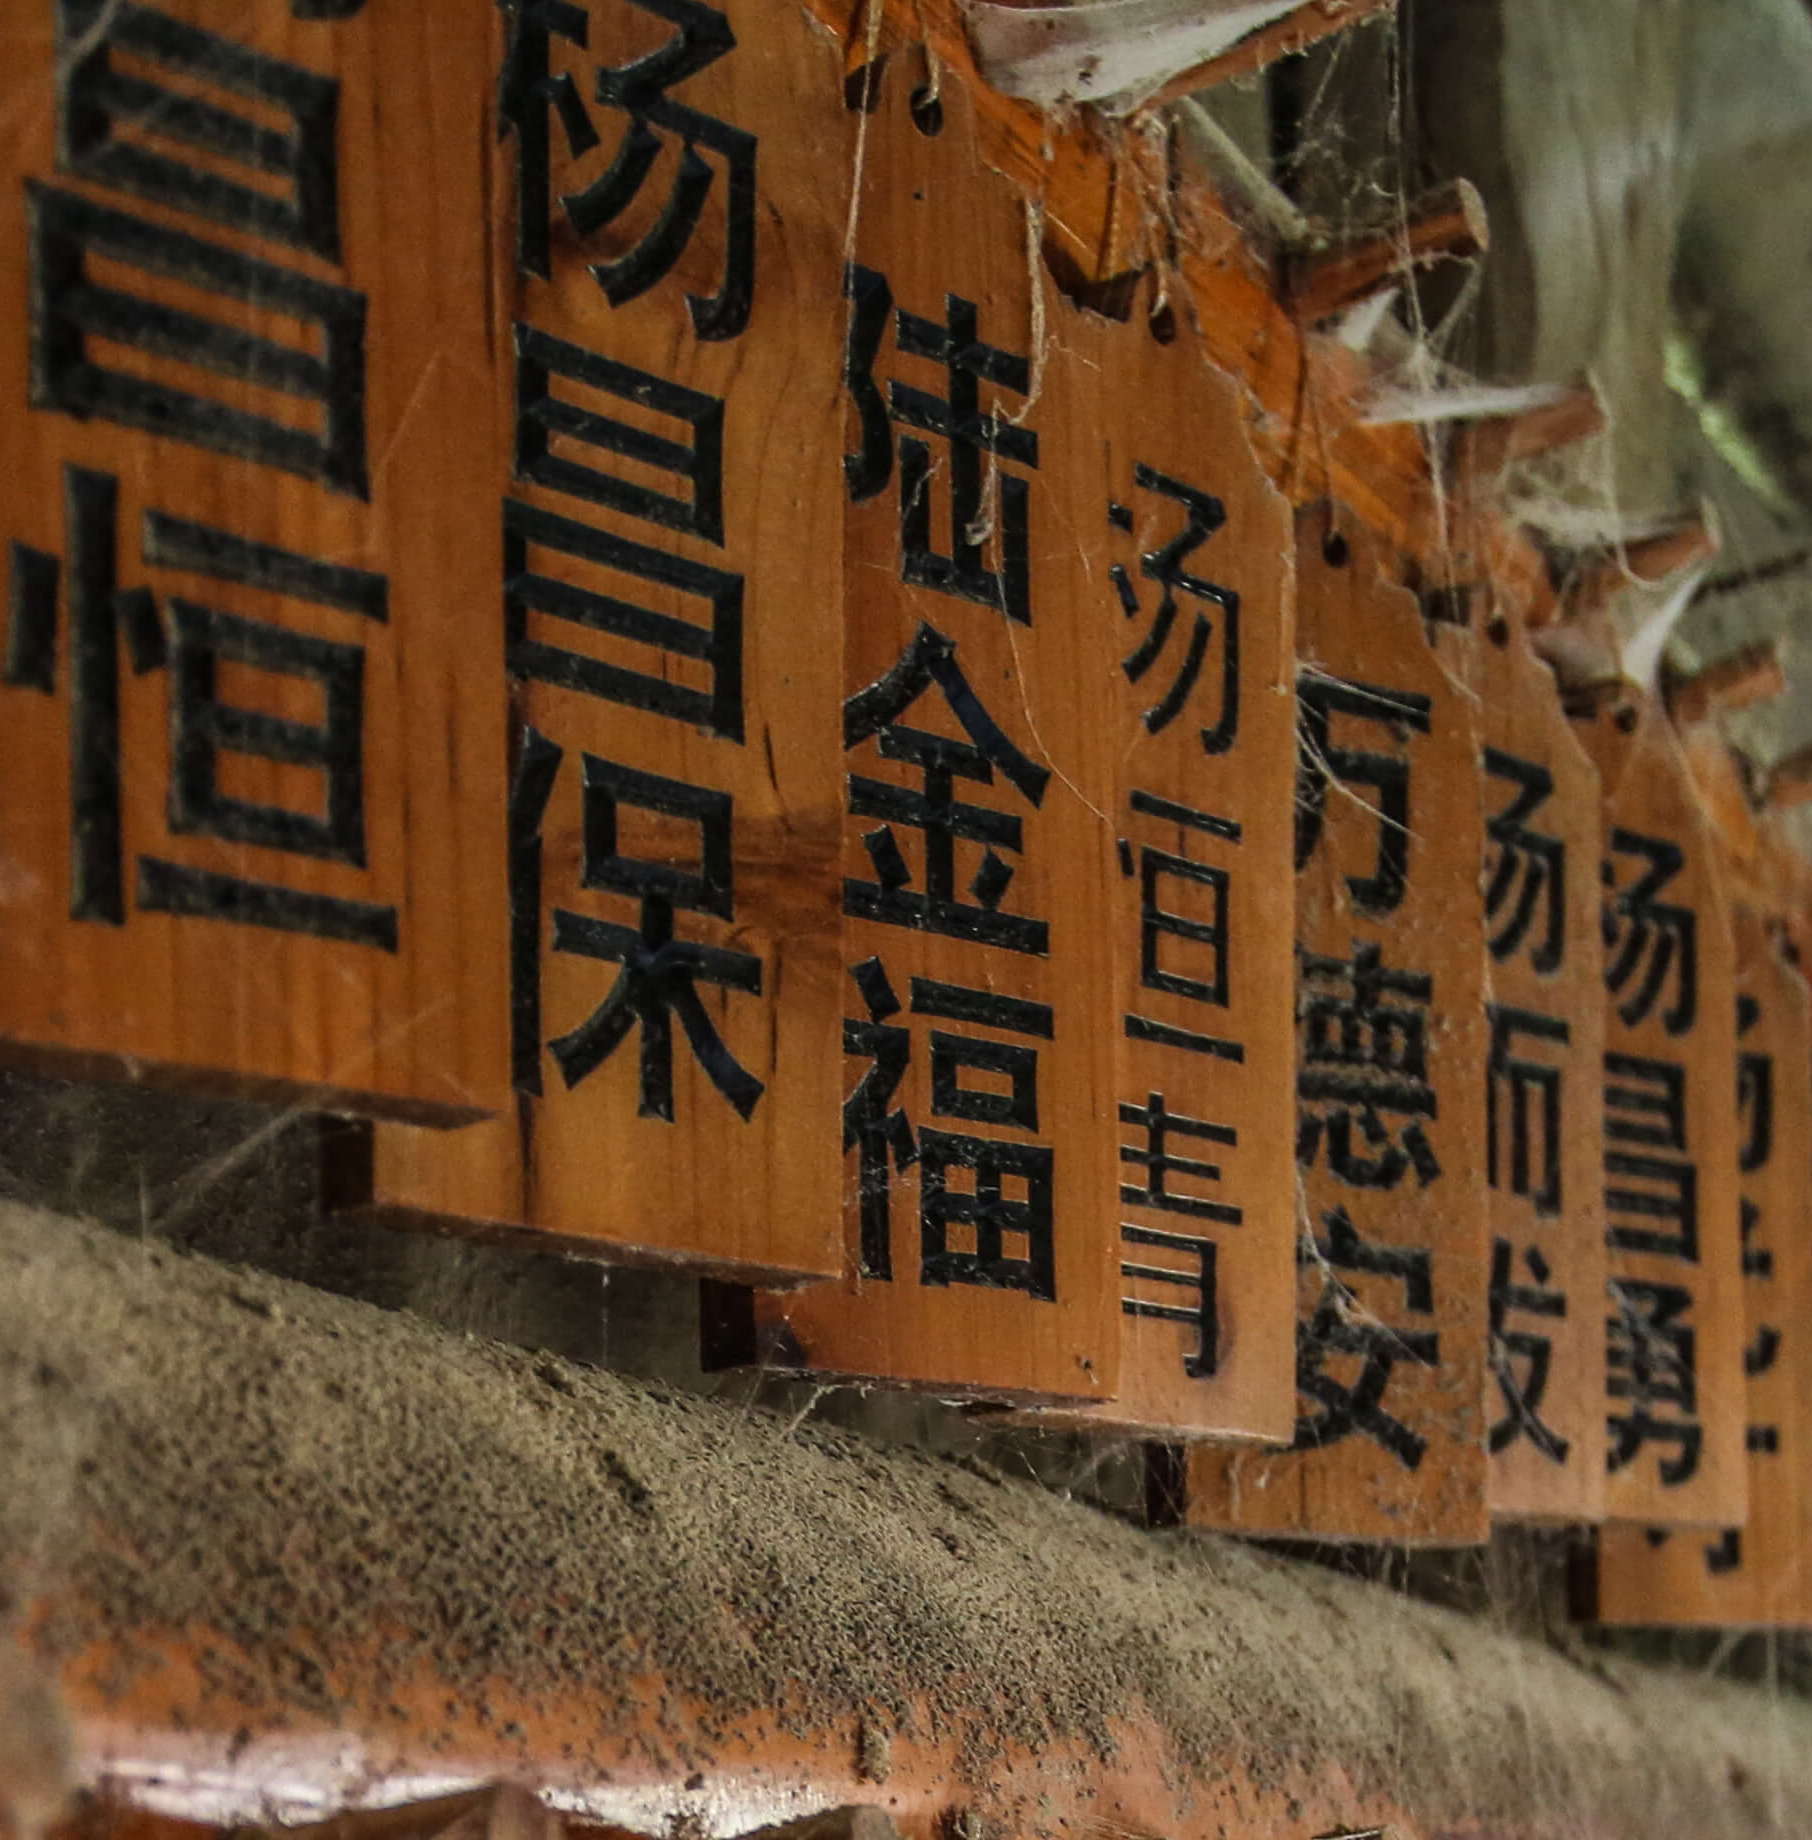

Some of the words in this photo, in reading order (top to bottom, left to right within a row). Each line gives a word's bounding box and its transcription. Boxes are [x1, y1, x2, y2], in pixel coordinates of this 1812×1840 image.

[0, 0, 399, 956] 昌恒
[499, 0, 765, 1123] 杨昌保
[842, 260, 1058, 1303] 陆金福
